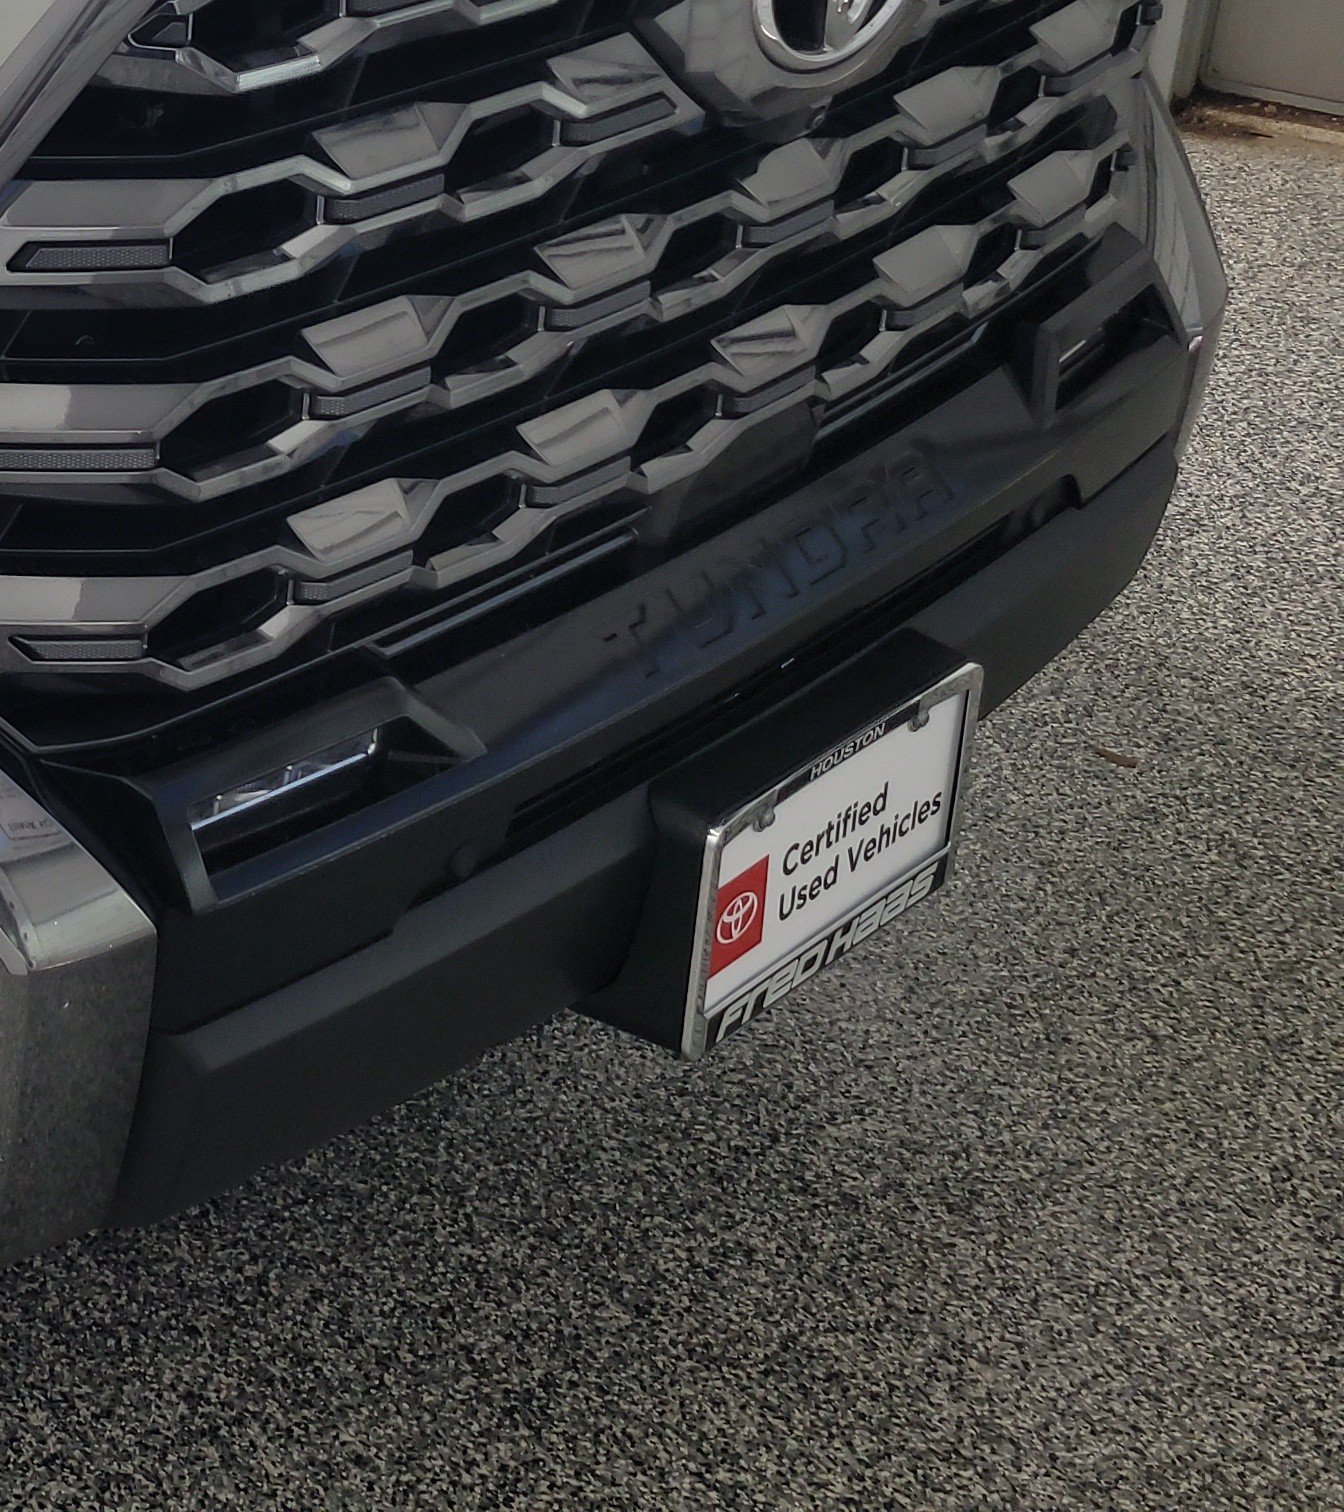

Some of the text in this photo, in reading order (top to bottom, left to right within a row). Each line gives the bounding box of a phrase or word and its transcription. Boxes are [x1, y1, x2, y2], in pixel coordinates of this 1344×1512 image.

[599, 452, 958, 679] TUNDRA
[810, 722, 887, 781] HOUSTON
[778, 790, 943, 921] Used Vehicles
[782, 781, 890, 876] Certified
